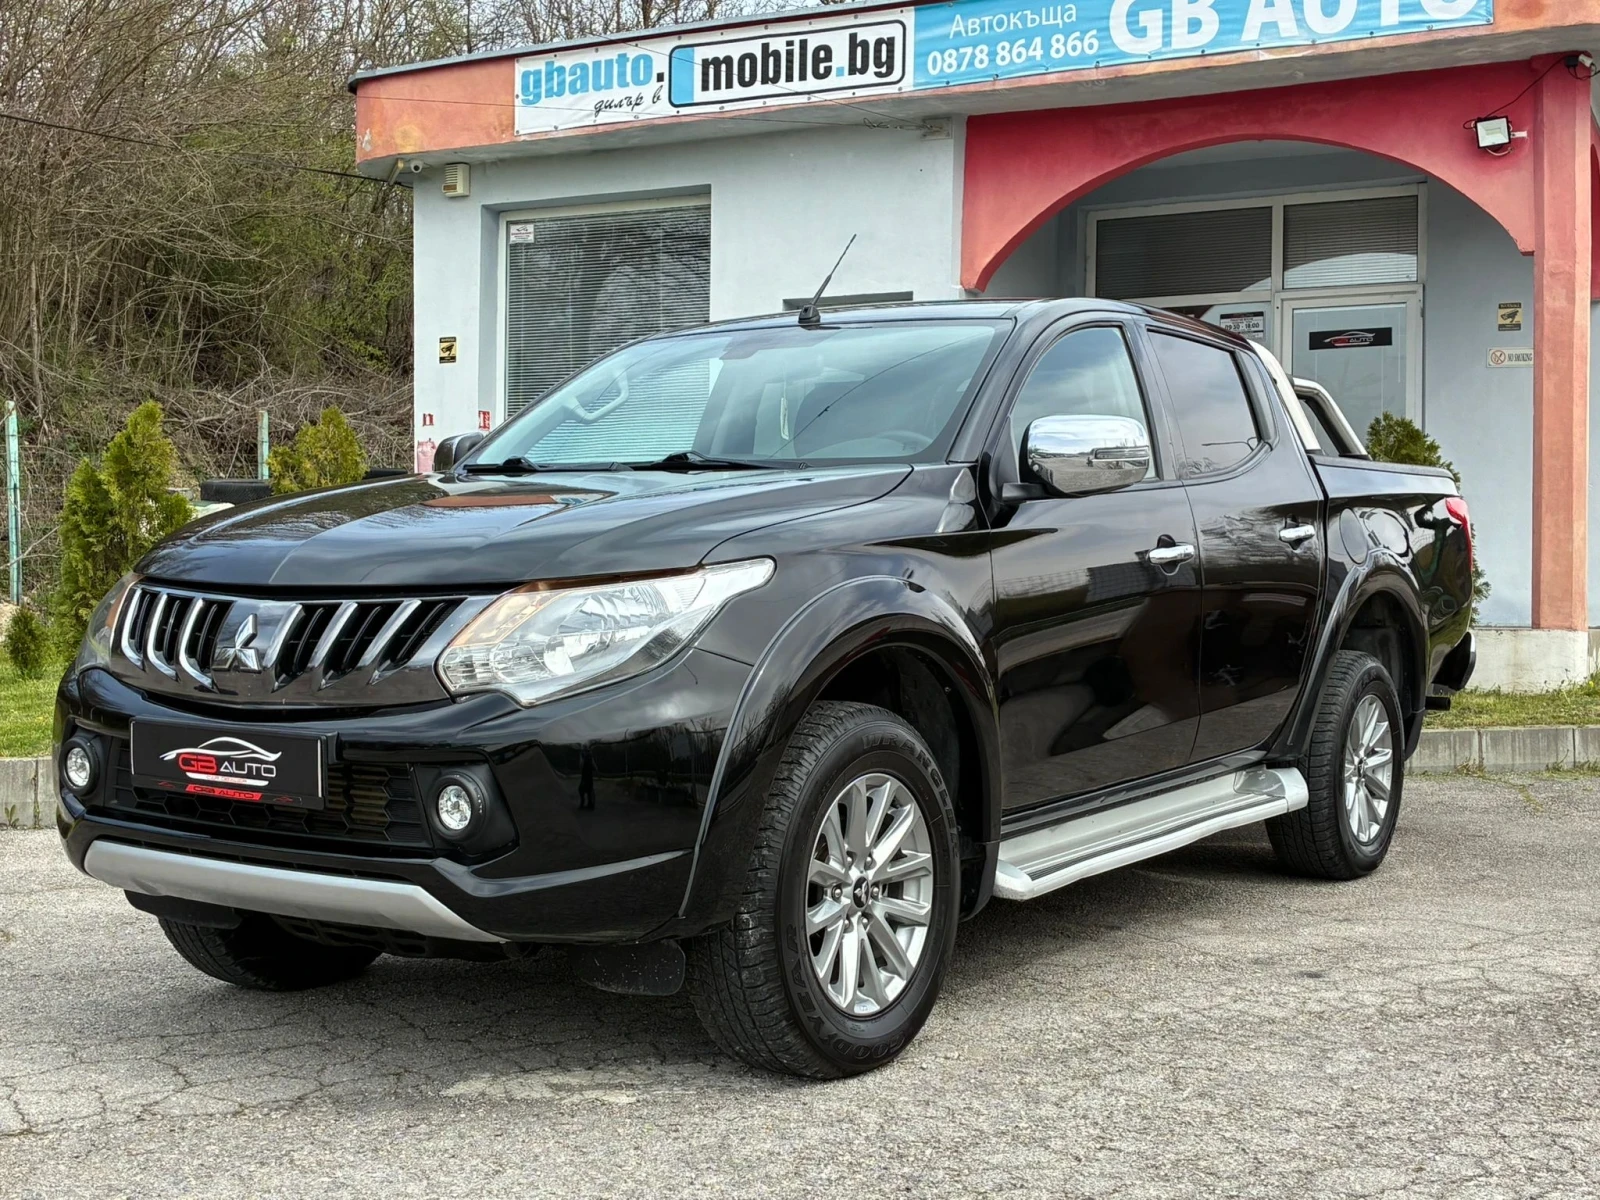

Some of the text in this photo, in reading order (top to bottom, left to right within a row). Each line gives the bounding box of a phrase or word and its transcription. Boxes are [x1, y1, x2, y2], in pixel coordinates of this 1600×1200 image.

[950, 4, 1077, 38] Автокъща
[1109, 0, 1220, 55] GB
[701, 32, 896, 91] mobile.bg
[927, 29, 1100, 75] 0878 864 866
[593, 84, 664, 118] дилър в
[179, 753, 277, 778] GB AUTO
[218, 788, 255, 799] AUTO
[787, 924, 907, 1060] GOODYEAR
